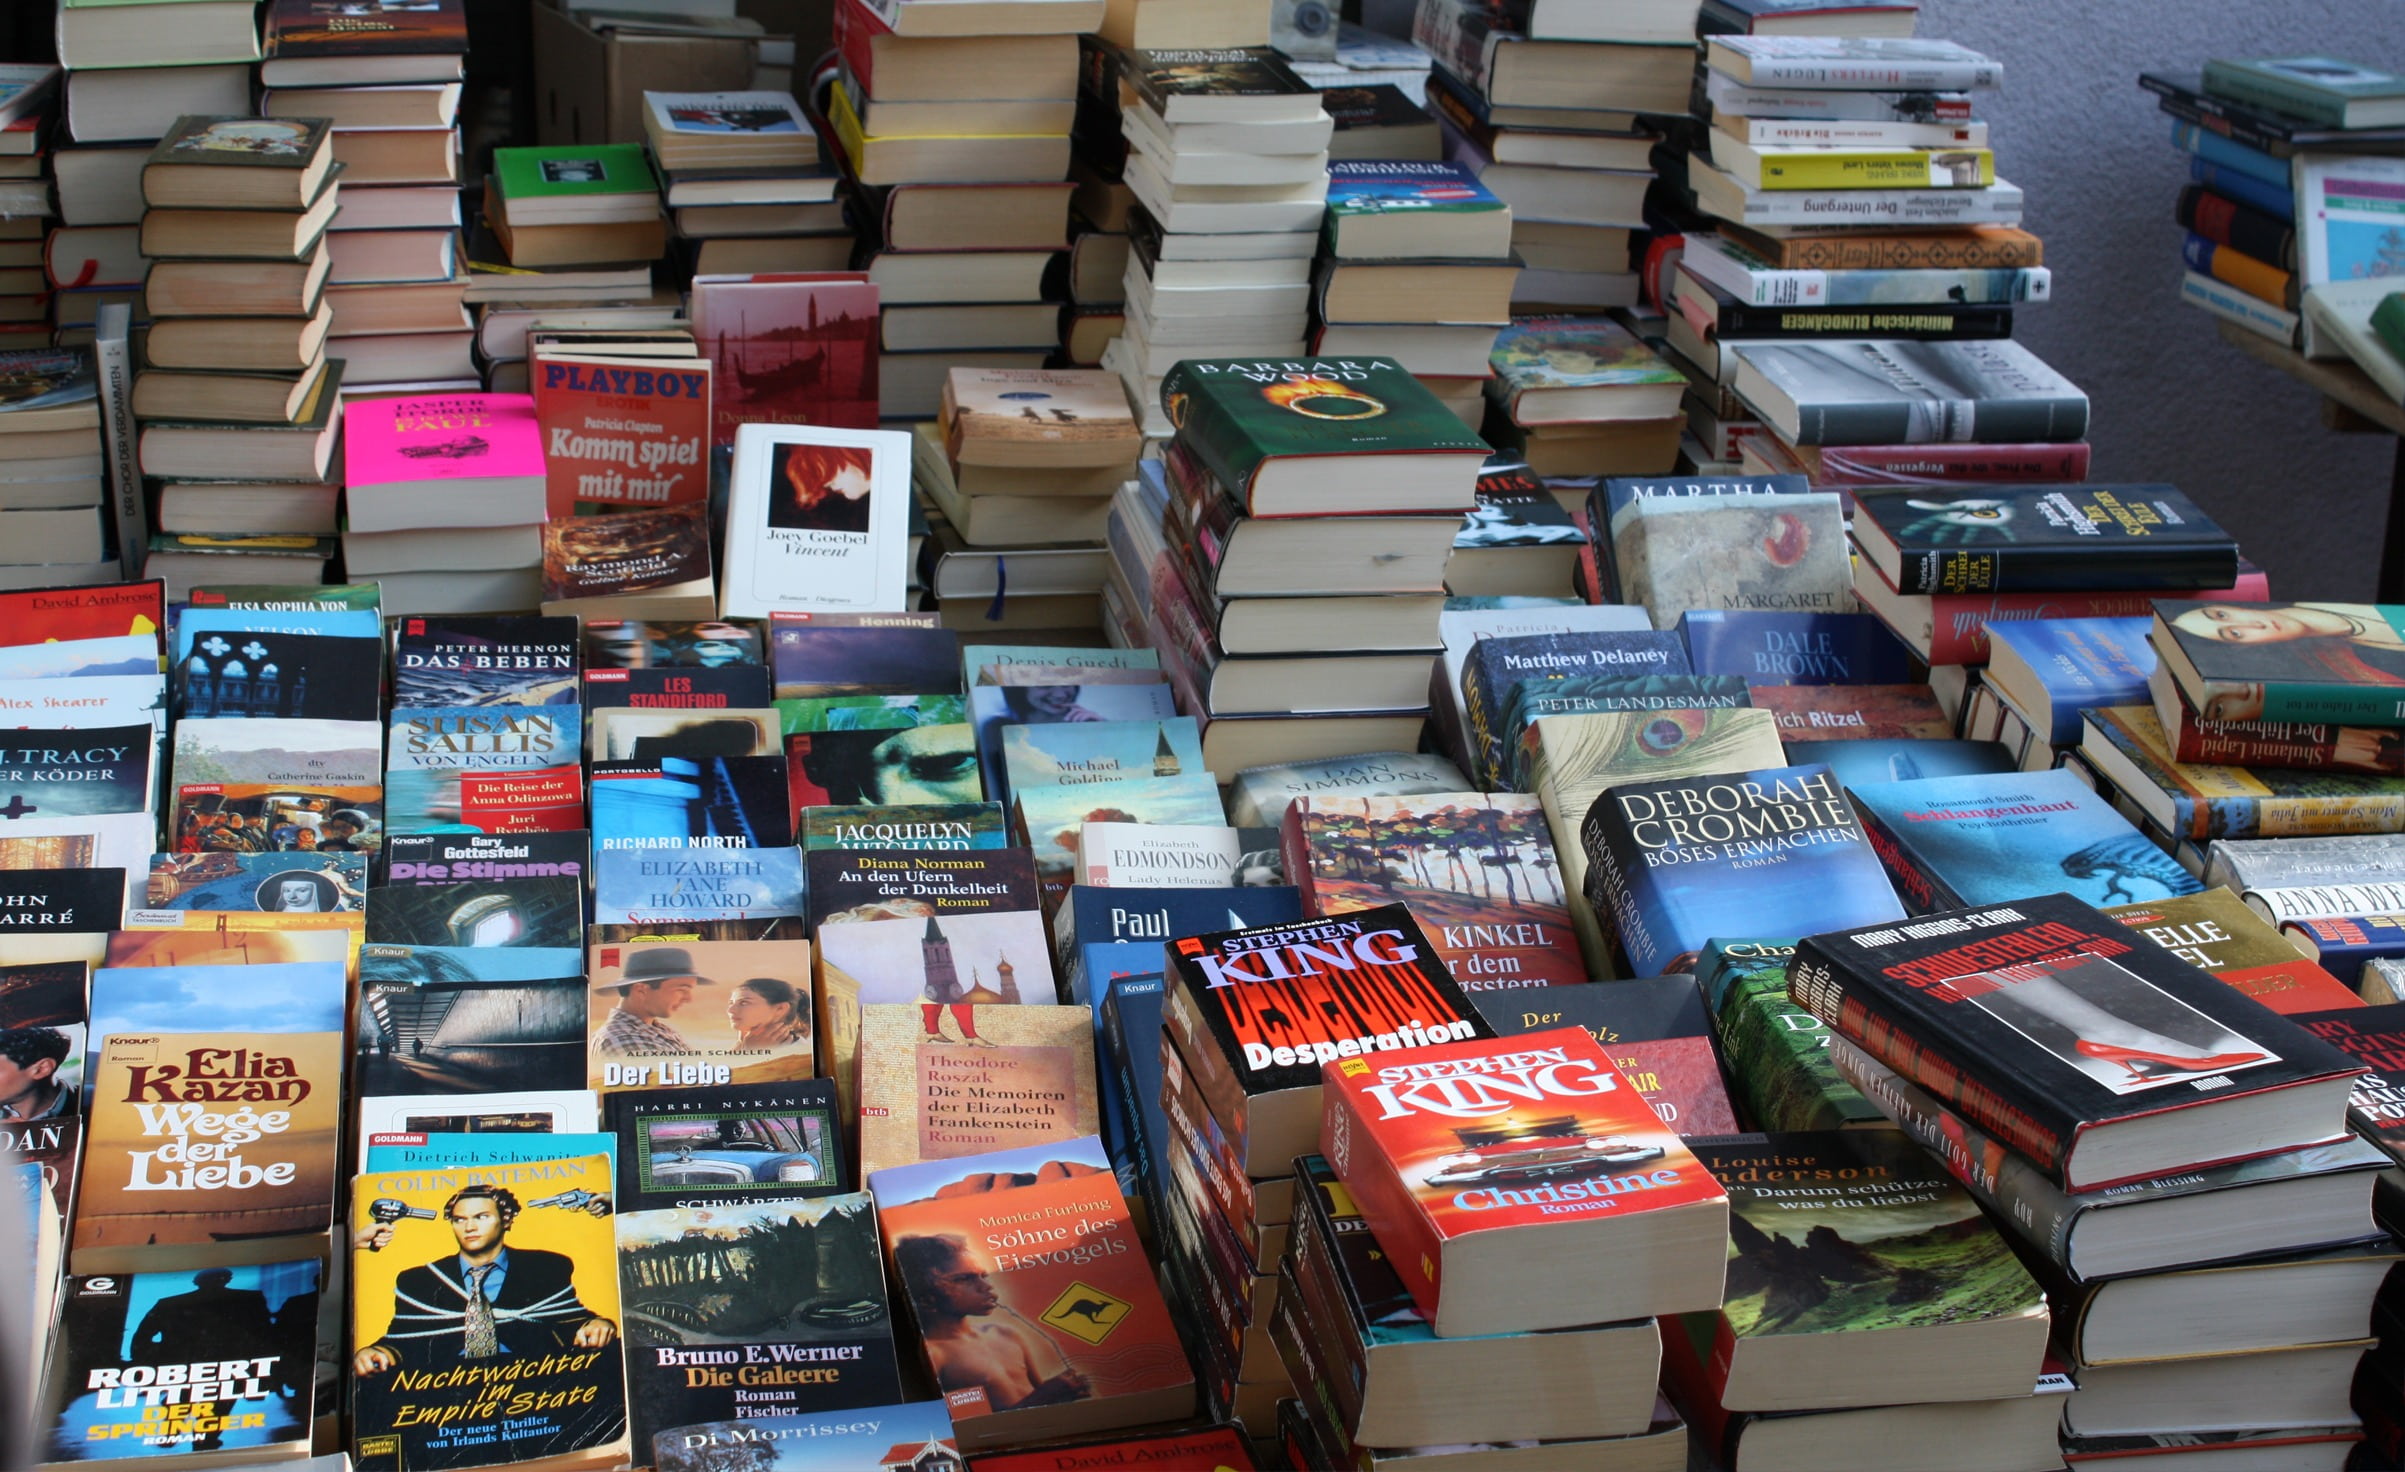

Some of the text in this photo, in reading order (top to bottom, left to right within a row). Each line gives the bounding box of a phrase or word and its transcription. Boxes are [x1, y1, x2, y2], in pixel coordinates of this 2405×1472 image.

[1803, 198, 1872, 215] Untergang
[1874, 202, 1898, 215] Der
[1781, 313, 1955, 331] Militärische BLINDGÄNGER
[1196, 358, 1394, 375] BARBARA
[1241, 368, 1369, 383] WOOD
[544, 364, 706, 399] PLAYBOY
[717, 410, 807, 424] Donna Leon
[110, 365, 136, 518] DER CHOR DER VERDAMMTEN
[550, 427, 700, 472] Komm spiel
[578, 469, 684, 501] mit mir
[766, 528, 869, 546] Joey Goebel
[782, 542, 852, 559] Vincent
[1917, 555, 1929, 591] Patricia
[1978, 553, 1991, 589] EULE
[1722, 592, 1835, 608] MARGARET
[859, 616, 934, 629] Henning
[435, 643, 572, 654] PETER HERNON
[1764, 629, 1834, 656] DALE
[405, 654, 573, 669] DAS BEBEN
[1504, 646, 1670, 670] Matthew Delaney
[1752, 651, 1851, 678] BROWN
[664, 677, 692, 694] LES
[43, 695, 109, 710] Shearer
[628, 693, 728, 708] STANDIFORD
[1537, 694, 1738, 712] PETER LANDESMAN
[407, 713, 554, 736] SUSAN
[1811, 710, 1866, 728] Ritzel
[406, 732, 556, 753] SALLIS
[2295, 724, 2327, 744] Der
[17, 745, 129, 765] TRACY
[412, 755, 551, 767] VON ENGELN
[2200, 738, 2325, 765] Shulamit Lapid
[307, 758, 327, 770] dtv
[593, 766, 662, 776] PORTOBELLO
[1056, 759, 1121, 772] Michael
[1323, 763, 1391, 780] DAN
[33, 766, 116, 783] KÖDER
[267, 771, 366, 783] Catherine Gaskin
[1285, 770, 1440, 793] SIMMONS
[477, 780, 565, 795] Die Reise der
[469, 790, 574, 806] Anna Odinzowa
[1617, 773, 1838, 824] DEBORAH
[1925, 792, 2035, 809] Rosamond Smith
[507, 813, 536, 825] Juri
[1903, 798, 2080, 824] Schlangenhaut
[2320, 806, 2366, 819] Sommer
[2368, 805, 2398, 818] Mein
[835, 822, 973, 844] JACQUELYN
[1632, 799, 1852, 850] CROMBIE
[1956, 816, 2049, 831] Psychothriller
[470, 837, 503, 850] Gary
[602, 835, 748, 849] RICHARD NORTH
[1142, 839, 1200, 849] Elizabeth
[1643, 827, 1861, 869] BÖSES ERWACHEN
[443, 846, 530, 860] Gottesfeld
[1113, 849, 1234, 871] EDMONDSON
[1732, 854, 1788, 870] ROMAN
[392, 860, 583, 881] Die Stimme
[639, 860, 762, 876] ELIZABETH
[858, 856, 986, 870] Diana Norman
[674, 877, 728, 893] JANE
[838, 869, 955, 883] An den Ufern
[878, 882, 1009, 896] der Dunkelheit
[1588, 817, 1658, 965] DEBORAH CROMBIE
[650, 892, 753, 909] HOWARD
[936, 896, 990, 908] Roman
[2275, 889, 2361, 918] ANNA
[1110, 907, 1171, 938] Paul
[1850, 907, 2028, 949] MARY HIGGINS-CLARK
[1222, 921, 1363, 954] STEPHEN
[1443, 923, 1554, 949] KINKEL
[374, 945, 406, 958] Knaur
[1190, 928, 1419, 990] KING
[1469, 953, 1521, 975] dem
[1124, 981, 1157, 993] Knaur
[1521, 1009, 1563, 1029] Der
[1243, 1018, 1478, 1072] Desperation
[183, 1047, 299, 1080] Elia
[925, 1054, 1019, 1070] Theodore
[1376, 1046, 1570, 1086] STEPHEN
[603, 1061, 732, 1087] Der Liebe
[927, 1070, 994, 1085] Roszak
[120, 1064, 313, 1108] Kazan
[927, 1085, 1067, 1101] Die Memoiren
[1361, 1059, 1618, 1121] KING
[634, 1096, 828, 1113] HARRI NYKÄNEN
[865, 1107, 888, 1117] btb
[927, 1100, 1056, 1116] der Elizabeth
[133, 1103, 290, 1144] Wege
[928, 1116, 1053, 1131] Frankenstein
[374, 1134, 423, 1145] GOLDMANN
[928, 1130, 997, 1145] Roman
[156, 1134, 238, 1164] der
[122, 1150, 296, 1192] Liebe
[1712, 1154, 1818, 1169] Louise
[378, 1161, 587, 1195] COLIN BATEMAN
[2103, 1174, 2205, 1197] ROMAN BLESSING
[1452, 1168, 1682, 1212] Christine
[1754, 1178, 1948, 1199] Darum schütze,
[1542, 1198, 1616, 1216] Roman
[1777, 1190, 1940, 1211] was du liebst
[978, 1198, 1112, 1230] Monica Furlong
[985, 1214, 1119, 1252] Söhne des
[992, 1236, 1128, 1274] Eisvogels
[87, 1355, 282, 1390] ROBERT
[390, 1349, 601, 1393] Nachtwächter
[684, 1364, 840, 1389] Die Galeere
[95, 1377, 271, 1410] LITTELL
[477, 1381, 513, 1403] im
[734, 1388, 797, 1403] Roman
[141, 1402, 217, 1422] DER
[392, 1384, 598, 1430] Empire State
[735, 1404, 800, 1420] Fischer
[85, 1412, 267, 1441] SPRINGER
[438, 1414, 550, 1438] Der neue Thriller
[683, 1419, 882, 1451] Di Morrissey
[142, 1432, 207, 1446] ROMAN
[425, 1423, 562, 1449] von Irlands Kultautor
